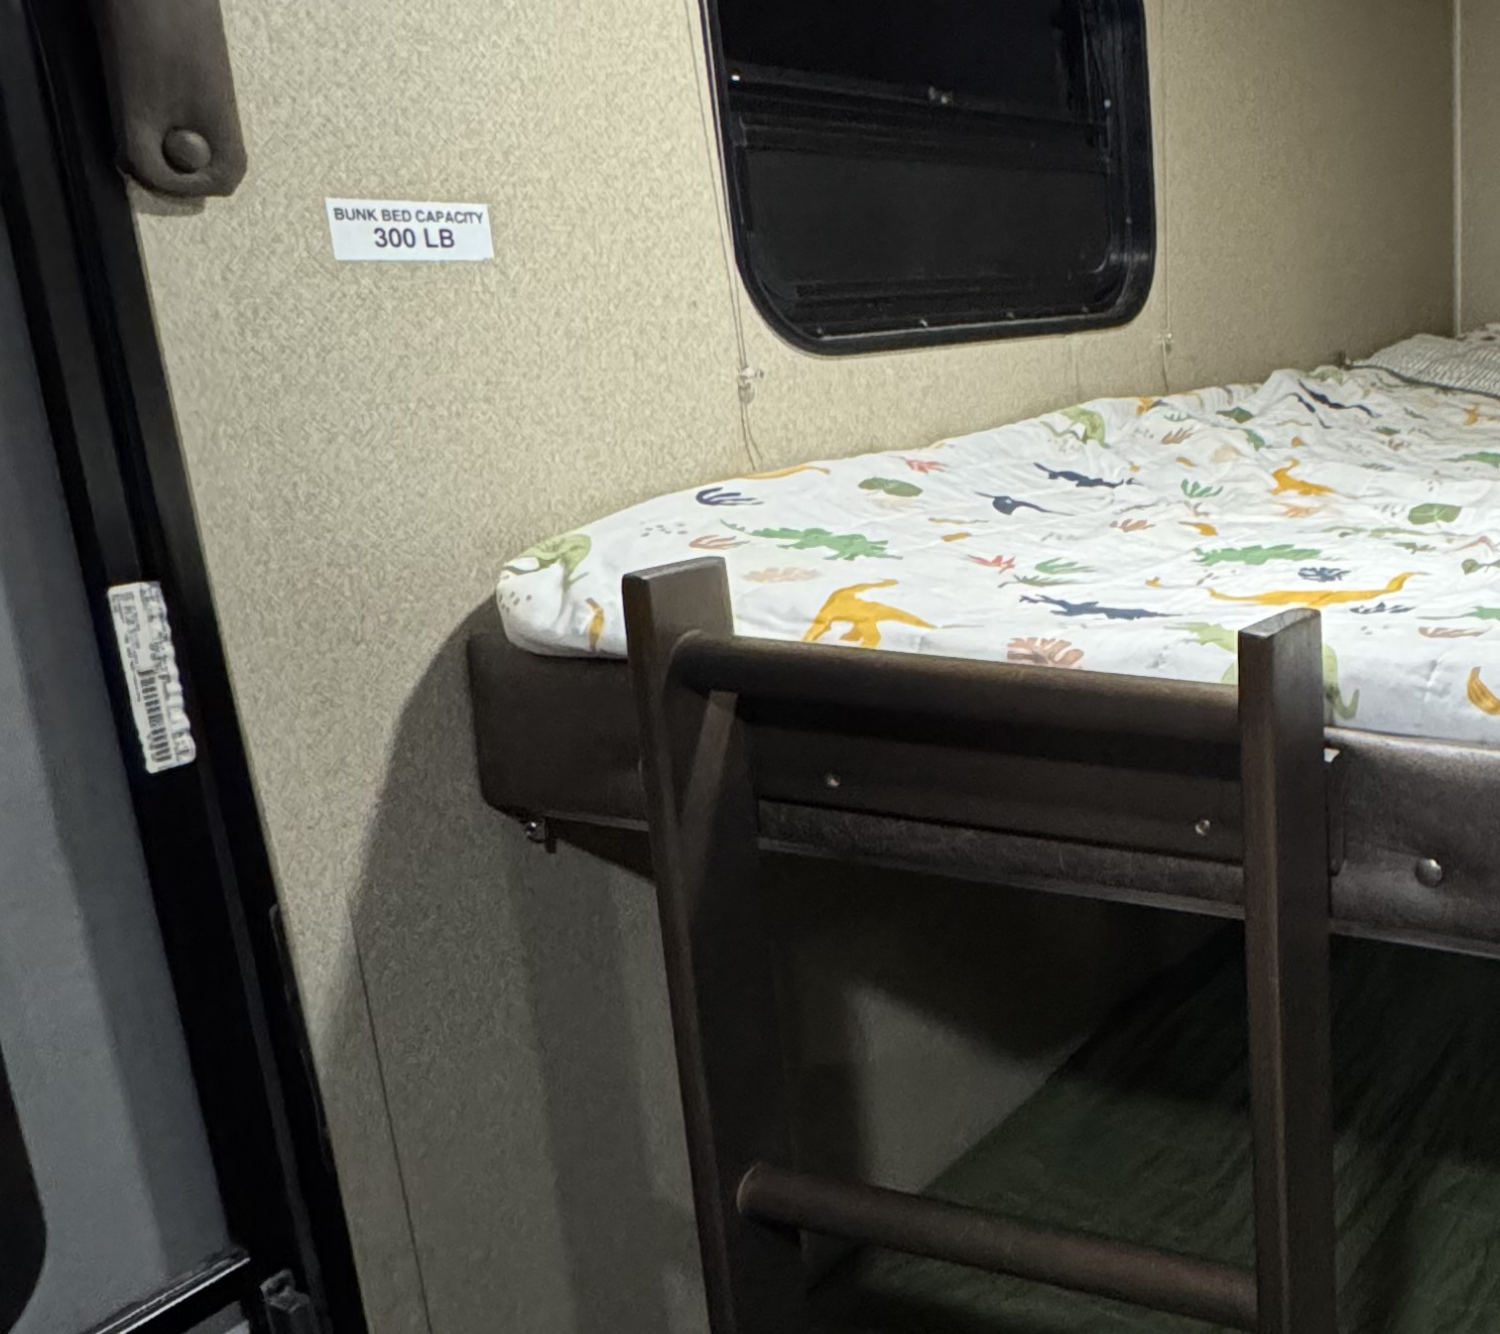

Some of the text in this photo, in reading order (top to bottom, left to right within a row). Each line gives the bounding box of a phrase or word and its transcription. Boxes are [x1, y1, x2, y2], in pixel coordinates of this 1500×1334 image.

[333, 207, 483, 224] BUNK BED CAPACITY
[373, 227, 455, 248] 300 LB
